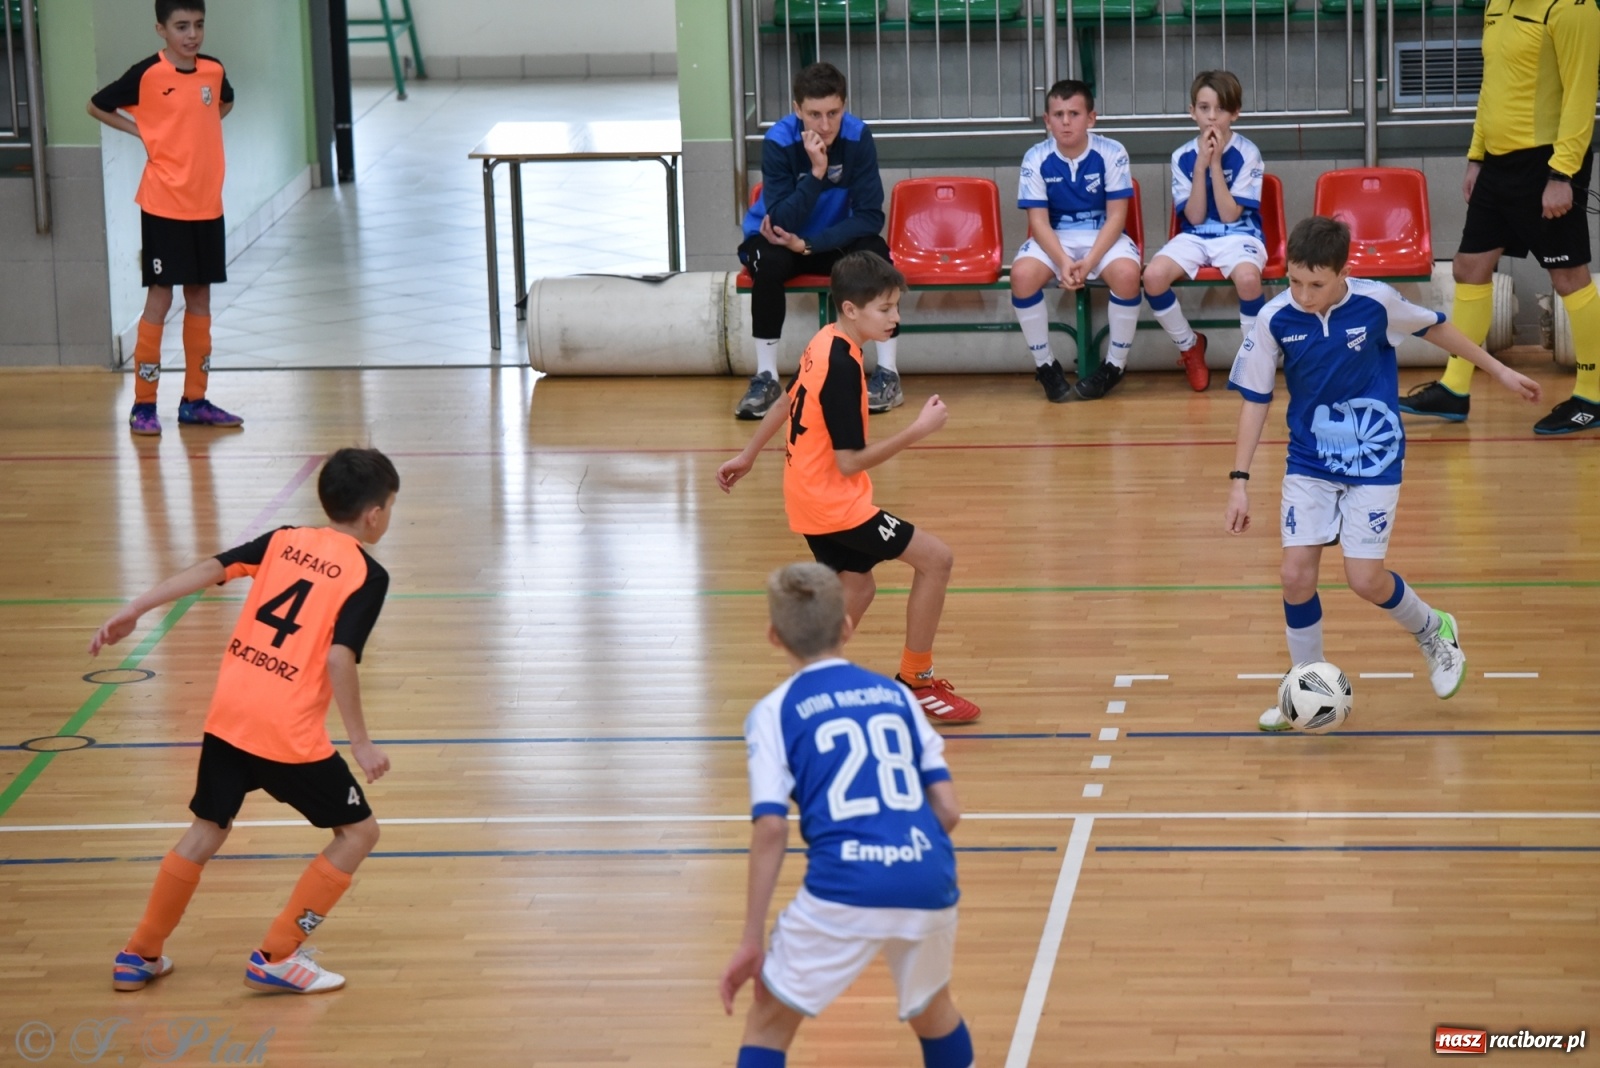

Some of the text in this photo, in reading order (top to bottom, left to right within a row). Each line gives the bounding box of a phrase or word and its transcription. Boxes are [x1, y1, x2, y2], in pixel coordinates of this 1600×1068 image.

[153, 258, 162, 274] 8
[1543, 255, 1569, 263] zina
[878, 513, 901, 542] 44
[1285, 505, 1297, 535] 4
[280, 546, 342, 579] RAFAKO
[255, 578, 314, 649] 4
[228, 638, 299, 682] RACIBORZ
[795, 692, 835, 720] UNIA
[815, 713, 924, 822] 28
[347, 785, 361, 806] 4
